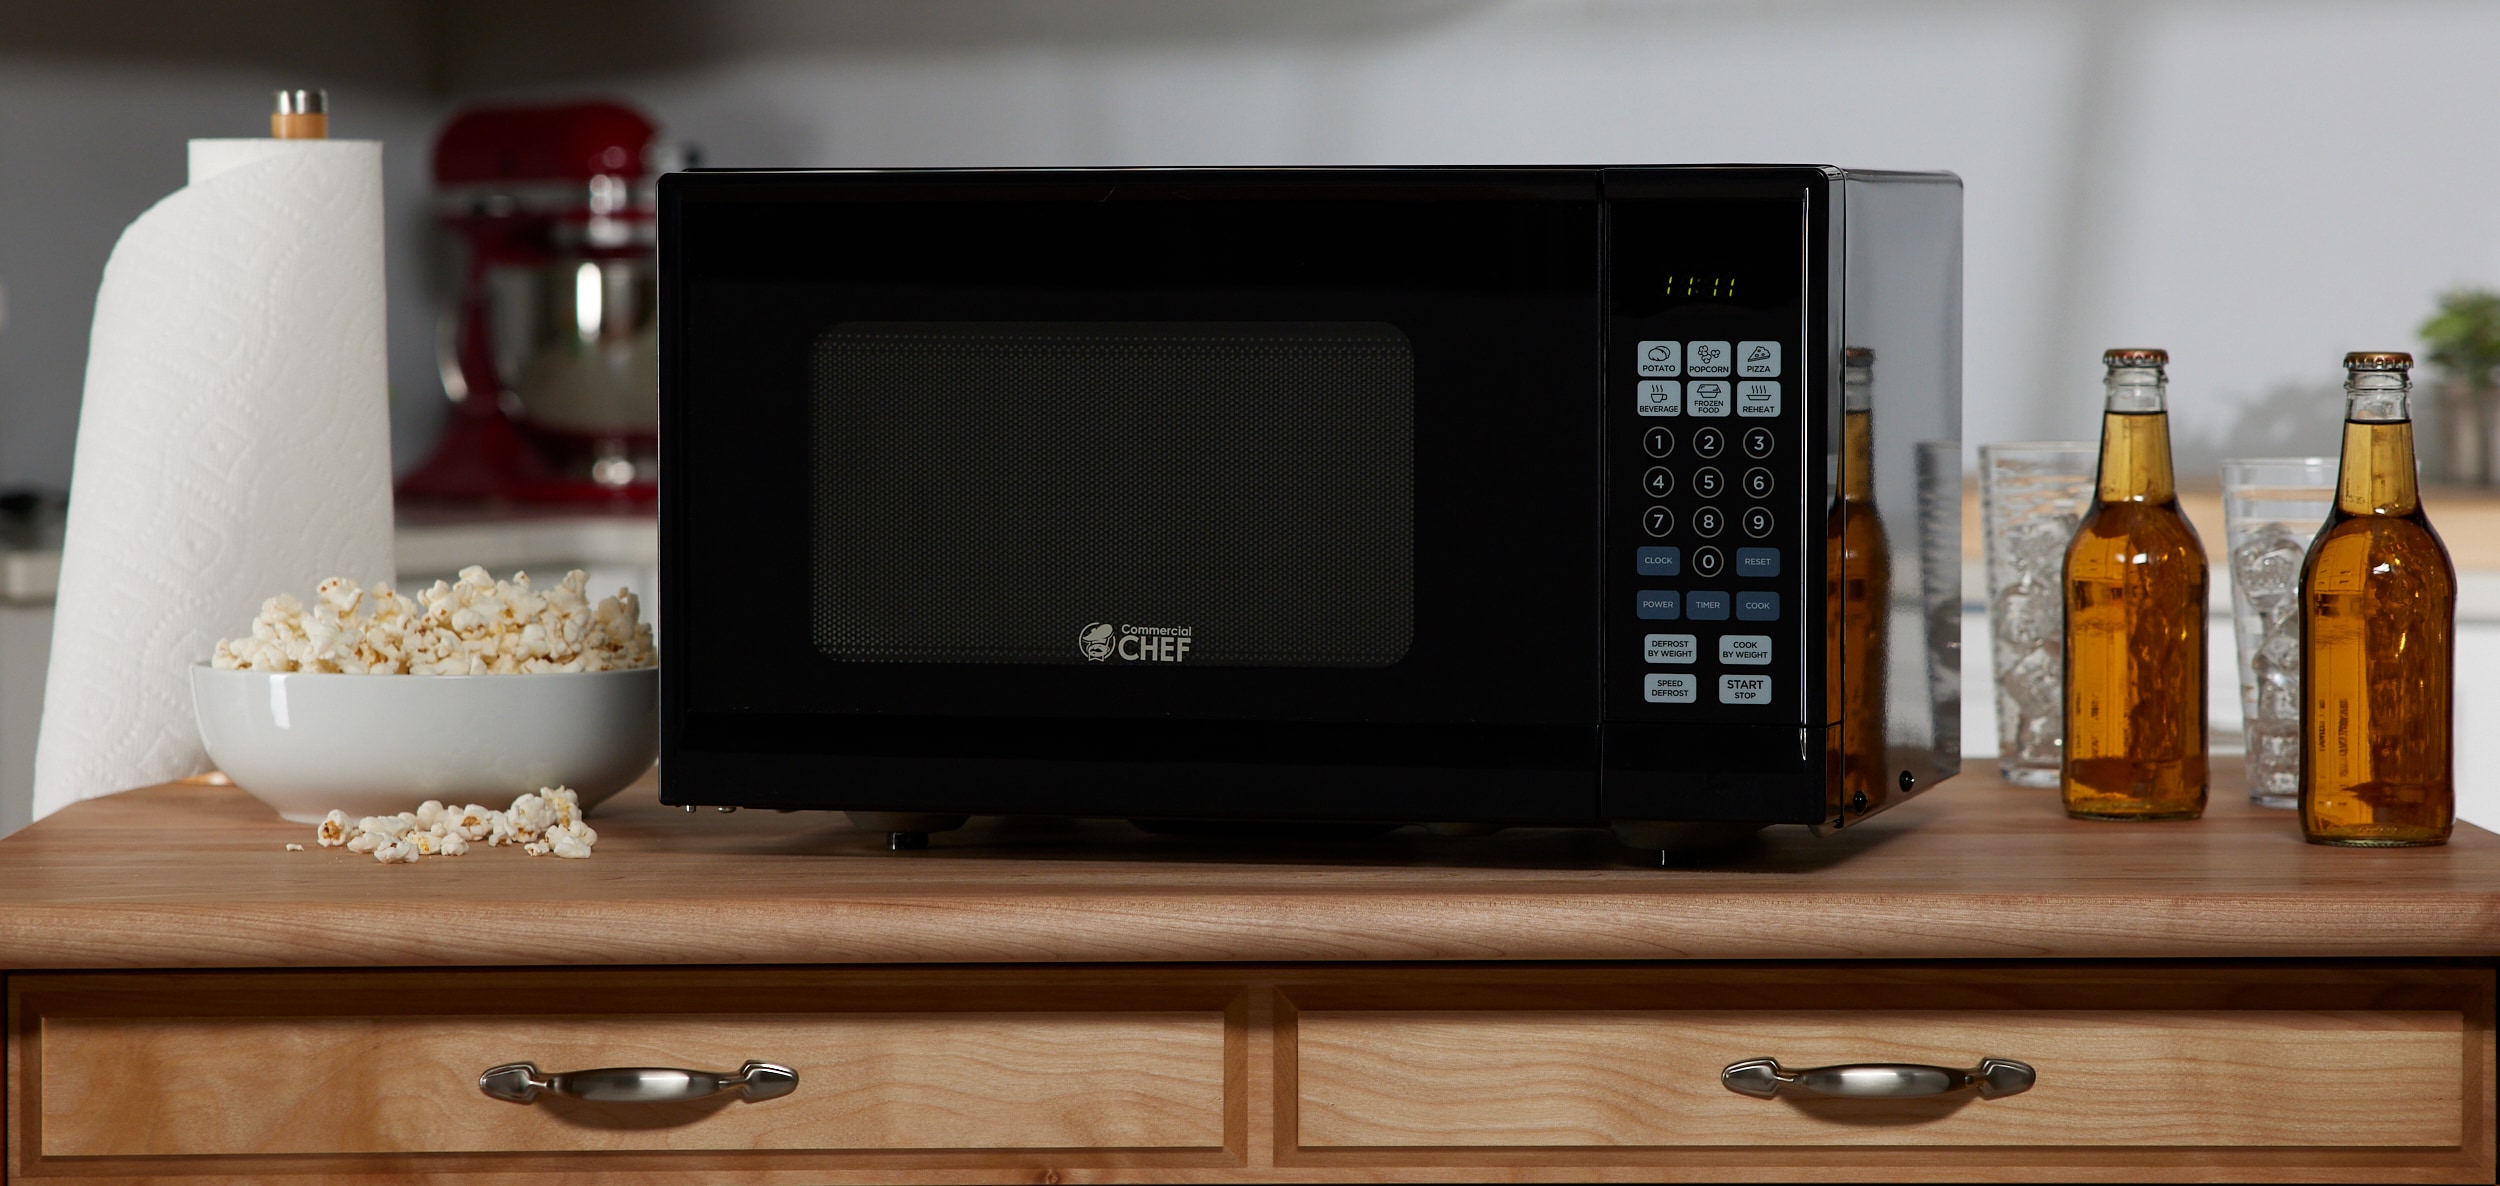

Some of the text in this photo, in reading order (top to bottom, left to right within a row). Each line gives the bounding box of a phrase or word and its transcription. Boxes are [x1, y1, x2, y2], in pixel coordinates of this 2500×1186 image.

[1655, 435, 1662, 449] 1
[1704, 435, 1714, 449] 2
[1754, 436, 1764, 450] 3
[1653, 475, 1664, 489] 4
[1704, 475, 1714, 490] 5
[1753, 476, 1765, 490] 6
[1654, 514, 1664, 528] 7
[1703, 514, 1714, 529] 8
[1753, 515, 1764, 530] 9
[1702, 554, 1715, 569] 0
[1745, 558, 1771, 566] RESET
[1696, 601, 1720, 609] TIMER
[1746, 602, 1770, 610] COOK
[1121, 624, 1192, 637] Commercial
[1118, 635, 1192, 662] CHEF
[1652, 640, 1689, 648] DEFROST
[1660, 650, 1693, 658] WEIGHT
[1735, 651, 1768, 659] WEIGHT
[1727, 680, 1764, 689] START
[1652, 689, 1689, 697] DEFROST
